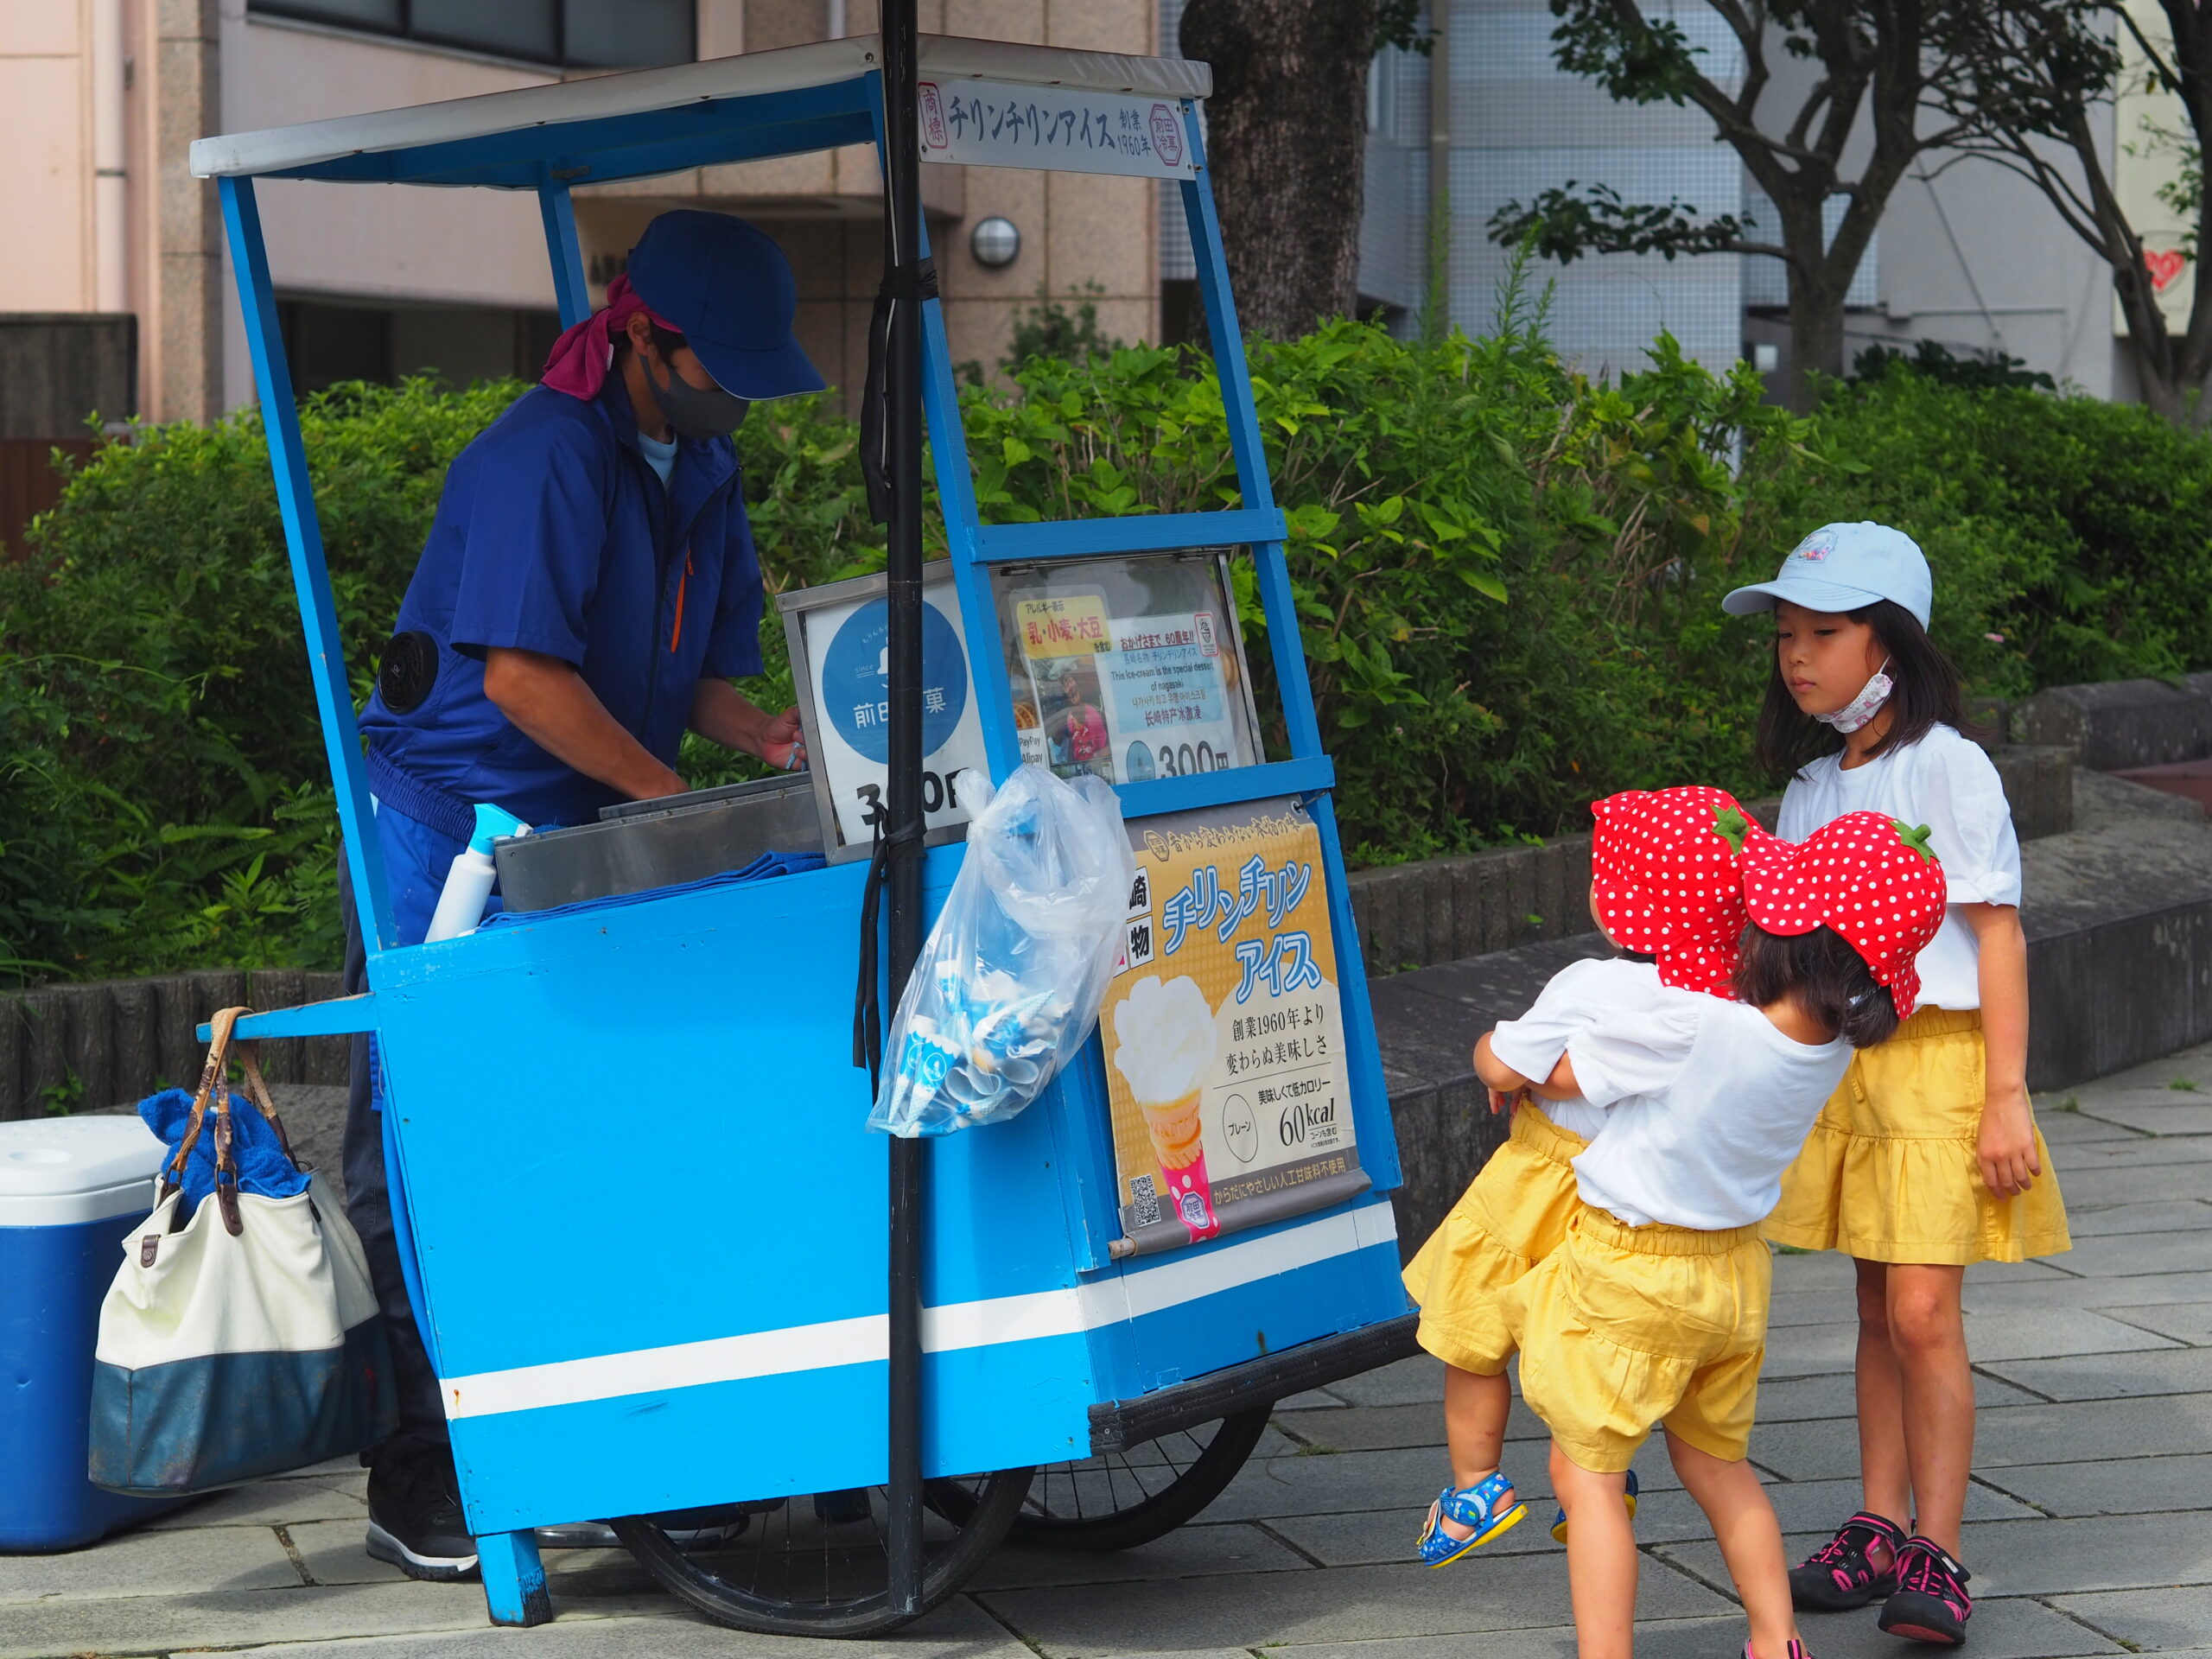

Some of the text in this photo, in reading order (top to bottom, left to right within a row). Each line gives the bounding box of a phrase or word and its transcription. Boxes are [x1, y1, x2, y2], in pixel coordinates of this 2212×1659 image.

[923, 89, 944, 143] 商標
[949, 95, 1116, 149] チリンチリンアイス
[1119, 108, 1142, 131] 創業
[1153, 116, 1174, 133] 前田
[1117, 135, 1152, 157] 1960年
[1121, 632, 1161, 650] おかげさまで
[855, 663, 874, 674] since
[1111, 671, 1126, 681] This
[1155, 665, 1162, 675] is
[1162, 664, 1173, 675] the
[1173, 662, 1193, 675] special
[1150, 678, 1184, 692] of nagasaki
[1020, 734, 1041, 749] PayPay
[1021, 752, 1044, 766] Alipay
[1163, 854, 1312, 956] チリンチリン
[1236, 931, 1322, 1004] アイス
[1232, 1003, 1324, 1042] 創業1960年より
[1225, 1034, 1328, 1077] 変わらぬ美味しさ
[1258, 1077, 1332, 1106] 美味しくて低カロリー
[1213, 1156, 1347, 1205] からだにやさしい人工甘味料不使用
